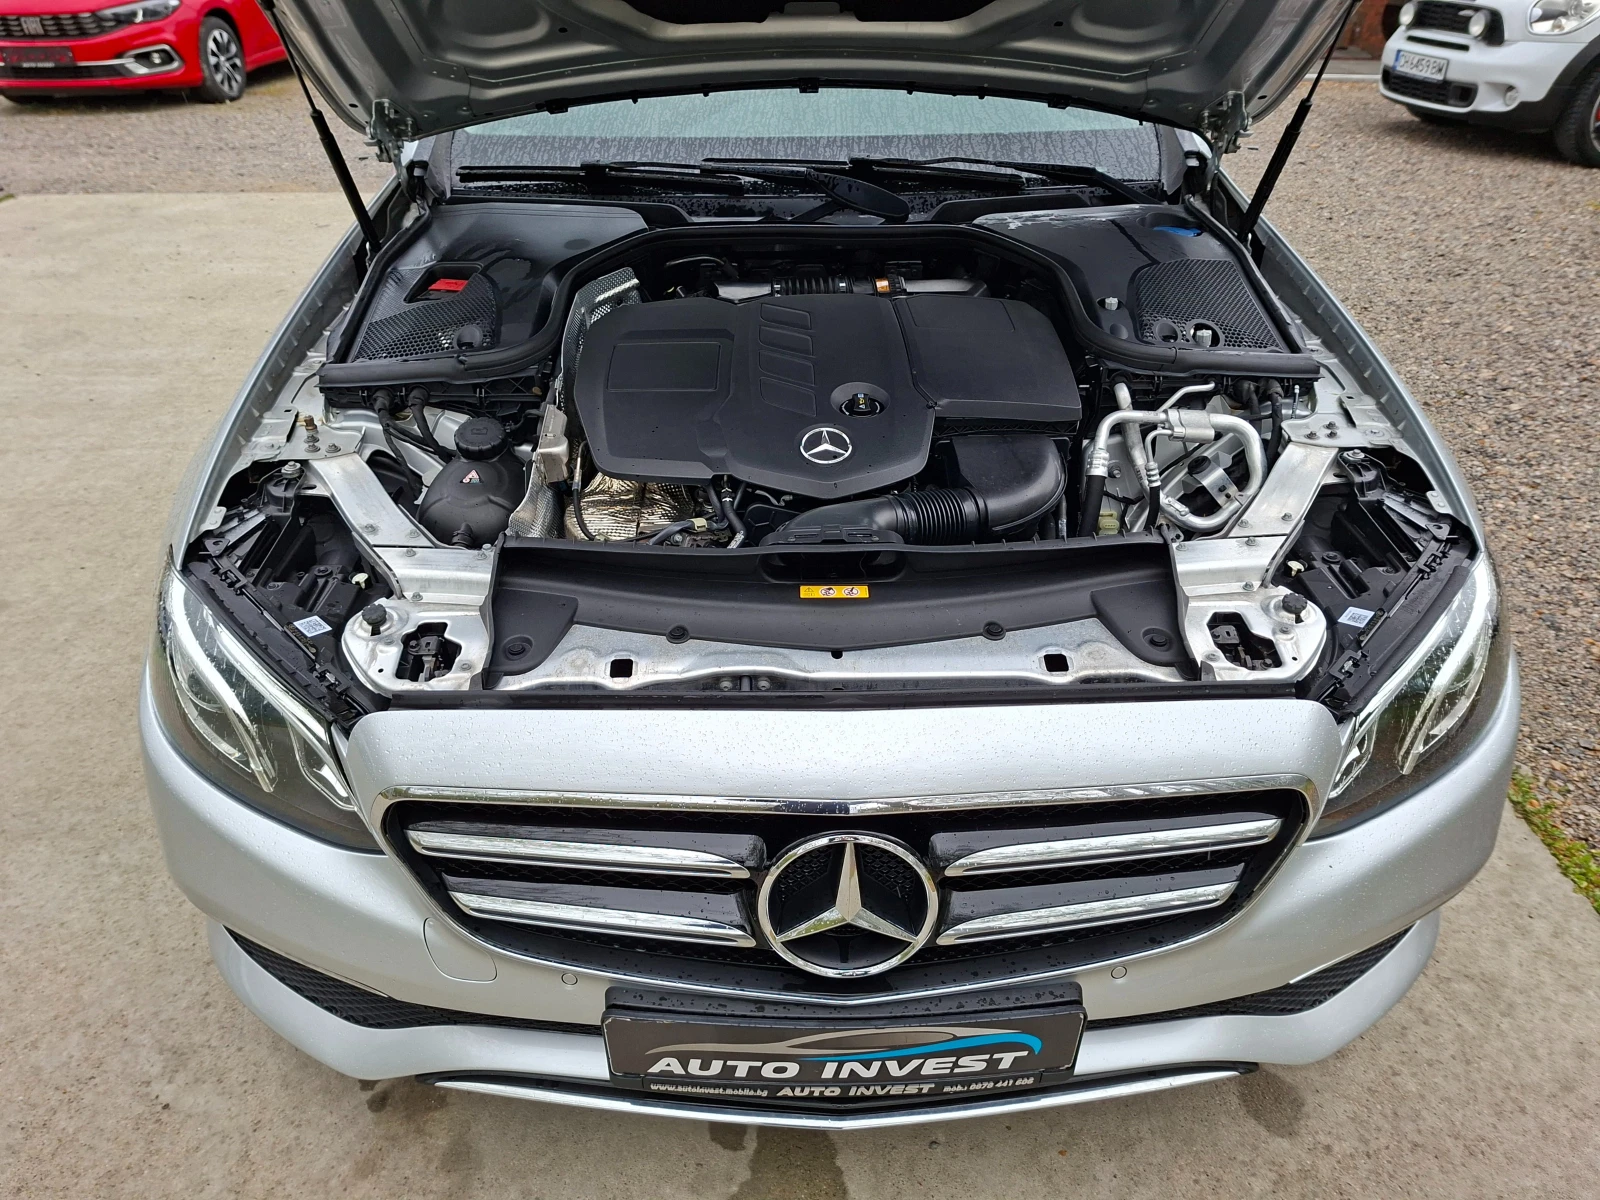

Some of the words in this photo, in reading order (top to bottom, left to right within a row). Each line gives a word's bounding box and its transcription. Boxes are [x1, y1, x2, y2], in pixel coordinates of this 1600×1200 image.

[647, 1057, 800, 1078] AUTO
[821, 1051, 1029, 1078] INVEST
[776, 1086, 841, 1097] AUTO
[848, 1083, 936, 1096] INVEST
[995, 1078, 1013, 1087] 441
